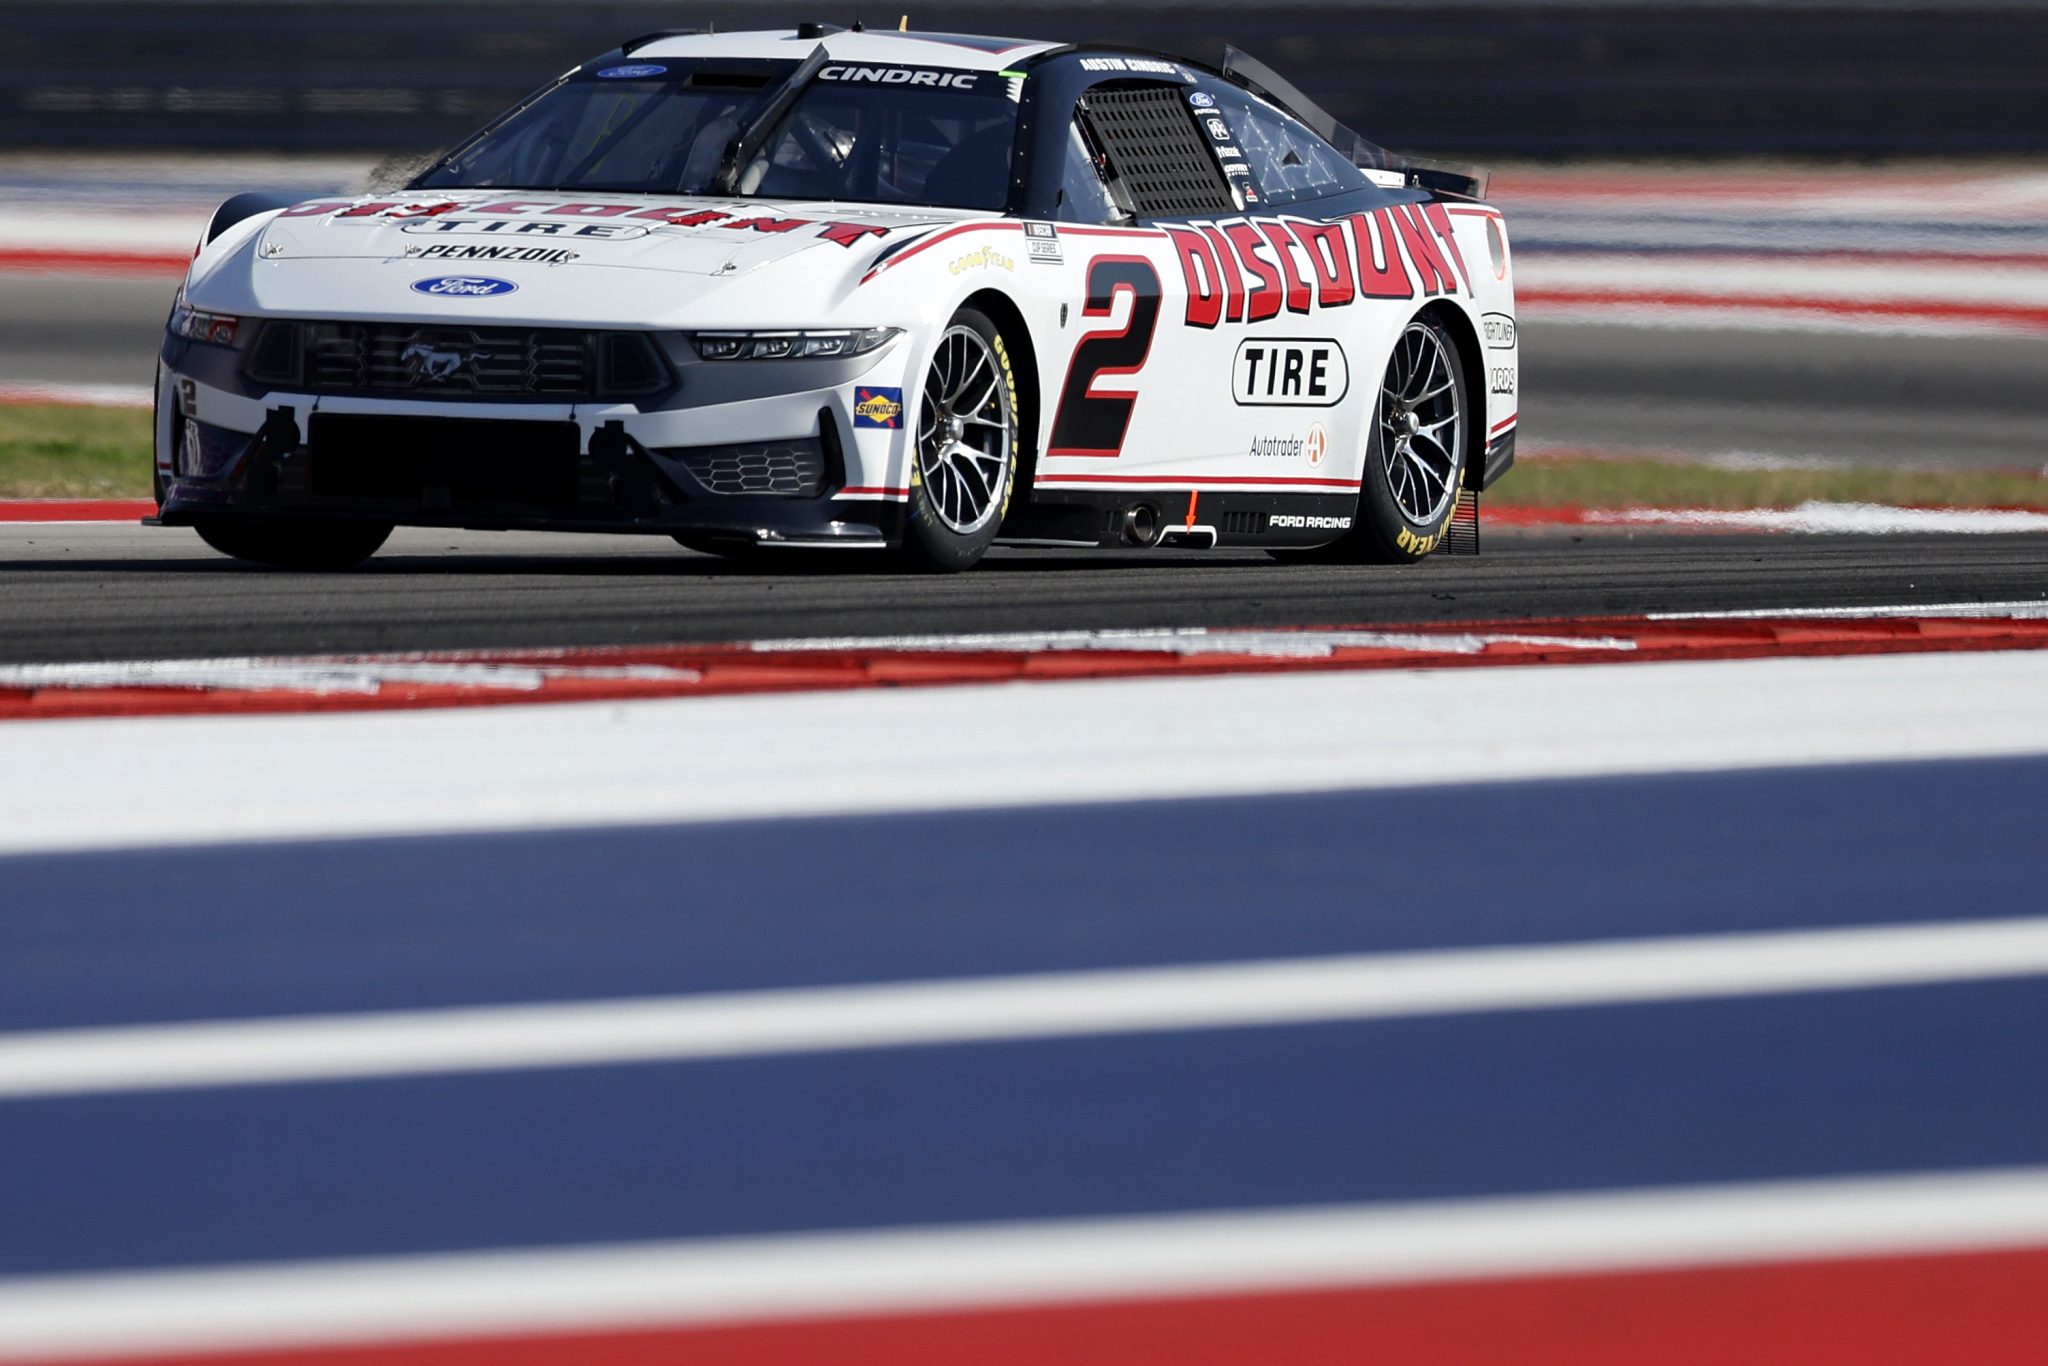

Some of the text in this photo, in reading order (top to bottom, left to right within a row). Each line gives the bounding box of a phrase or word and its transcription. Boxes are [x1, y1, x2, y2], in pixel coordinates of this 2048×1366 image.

[1080, 58, 1127, 71] AUSTIN
[1124, 59, 1176, 74] CINDRIC
[818, 66, 978, 89] CINDRIC
[435, 220, 623, 238] TIRE
[417, 244, 569, 263] PENNZOIL
[948, 249, 1015, 275] GOODYEAR
[1162, 203, 1477, 330] DISCOUNT
[1046, 254, 1163, 458] 2
[1245, 349, 1329, 397] TIRE
[858, 403, 899, 415] SUNOCO
[1249, 434, 1304, 456] Autotrader
[1269, 515, 1351, 529] FORD RACING
